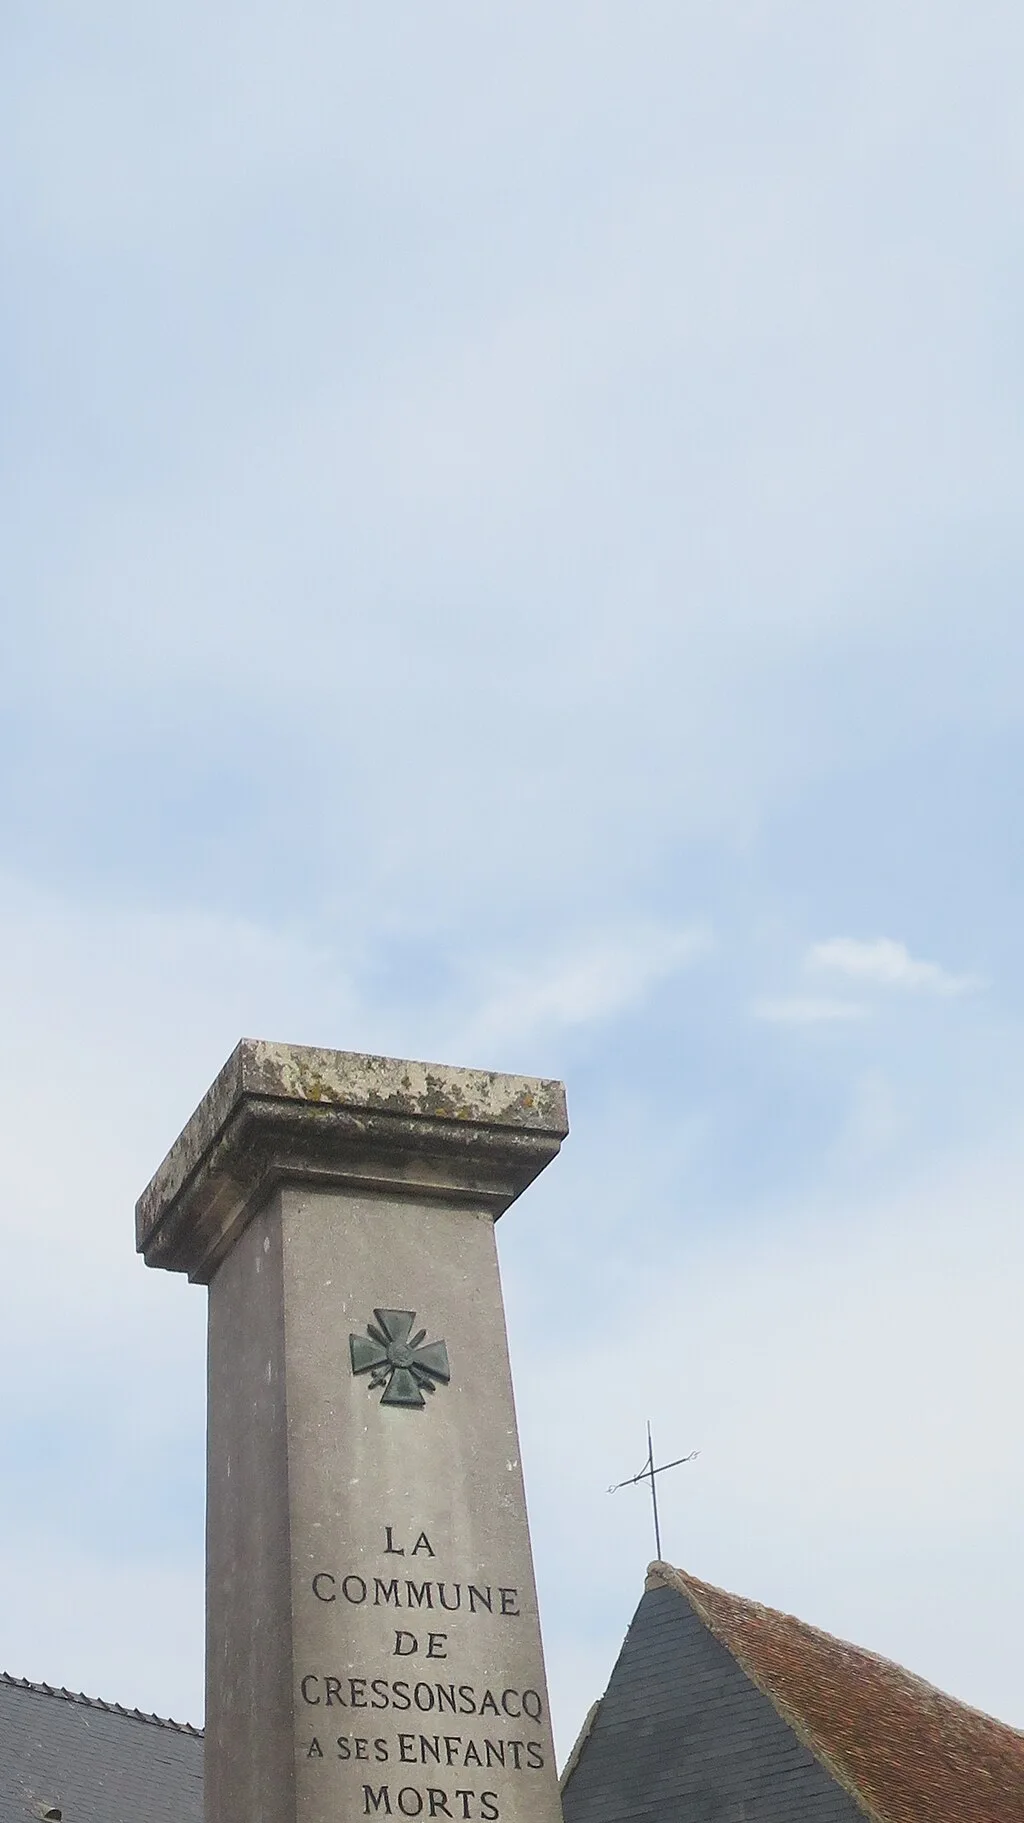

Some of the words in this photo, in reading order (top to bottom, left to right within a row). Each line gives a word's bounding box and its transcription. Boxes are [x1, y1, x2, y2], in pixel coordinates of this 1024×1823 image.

[384, 1526, 435, 1557] LA
[312, 1573, 520, 1617] COMMUNE
[393, 1630, 447, 1659] DE
[301, 1675, 542, 1724] CRESSONSACQ
[307, 1737, 323, 1759] A
[338, 1736, 389, 1761] SES
[398, 1734, 544, 1770] ENFANTS
[362, 1785, 500, 1821] MORTS
